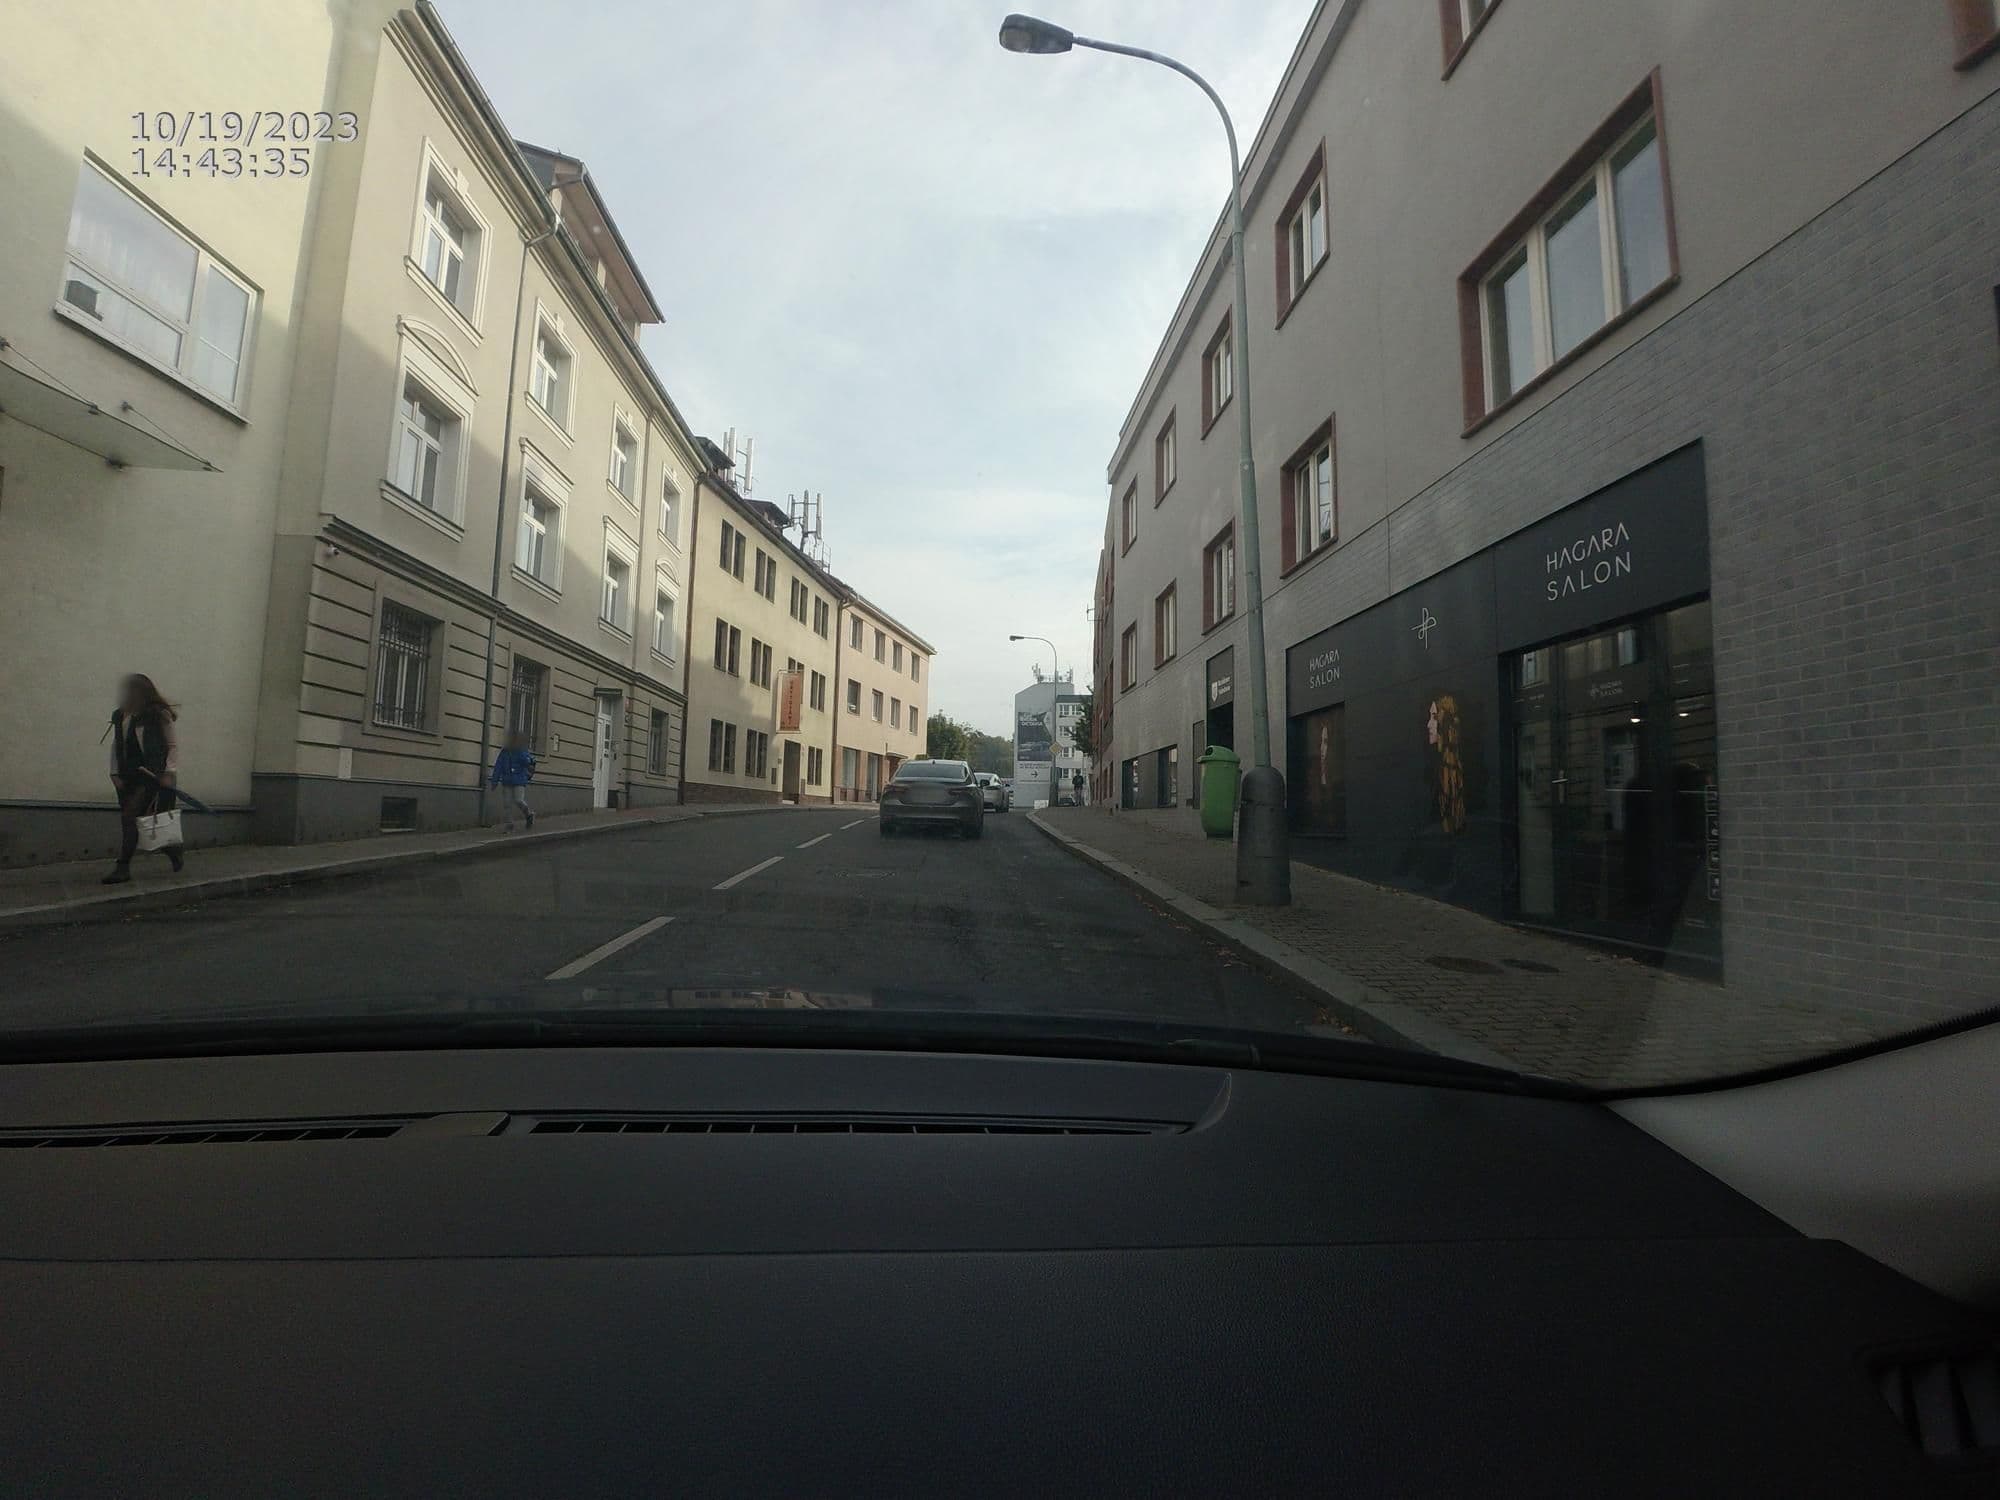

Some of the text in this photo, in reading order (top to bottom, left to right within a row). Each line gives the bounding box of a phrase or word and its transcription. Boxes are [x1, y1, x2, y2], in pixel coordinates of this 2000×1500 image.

[1546, 522, 1630, 574] HAGARA
[1547, 552, 1632, 601] SALON
[1309, 649, 1340, 671] HAGARA
[1309, 667, 1340, 689] SALON
